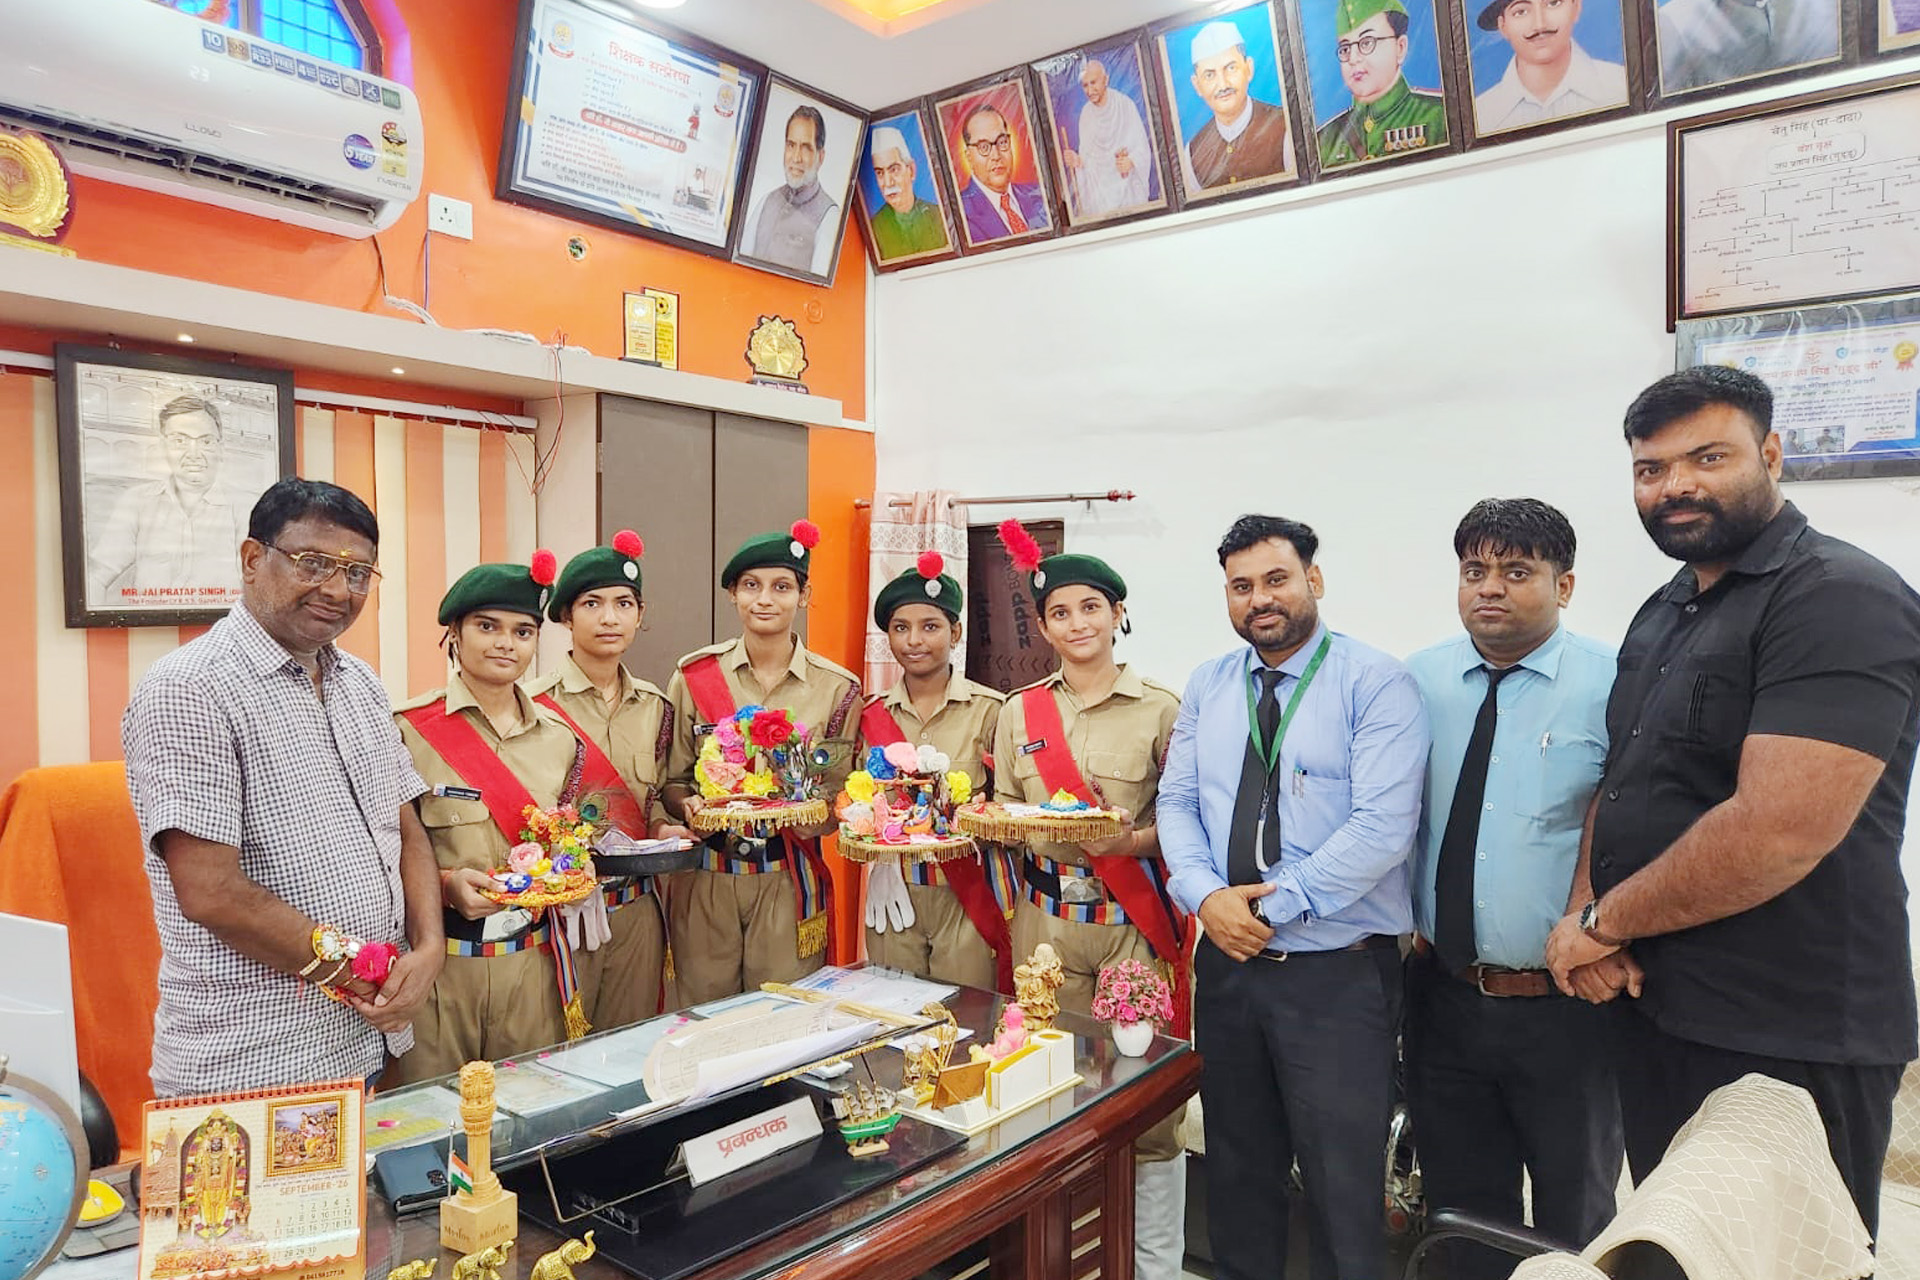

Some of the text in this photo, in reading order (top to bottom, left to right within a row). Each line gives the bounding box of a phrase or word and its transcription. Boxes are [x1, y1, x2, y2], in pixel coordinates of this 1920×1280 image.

[204, 32, 222, 48] 10
[608, 41, 645, 67] शिक्षक
[190, 65, 210, 82] 23
[143, 588, 157, 596] JAI
[160, 587, 196, 596] PRATAP
[199, 587, 226, 596] SINGH
[1012, 592, 1031, 649] zapp
[717, 1115, 789, 1158] प्रबन्धक
